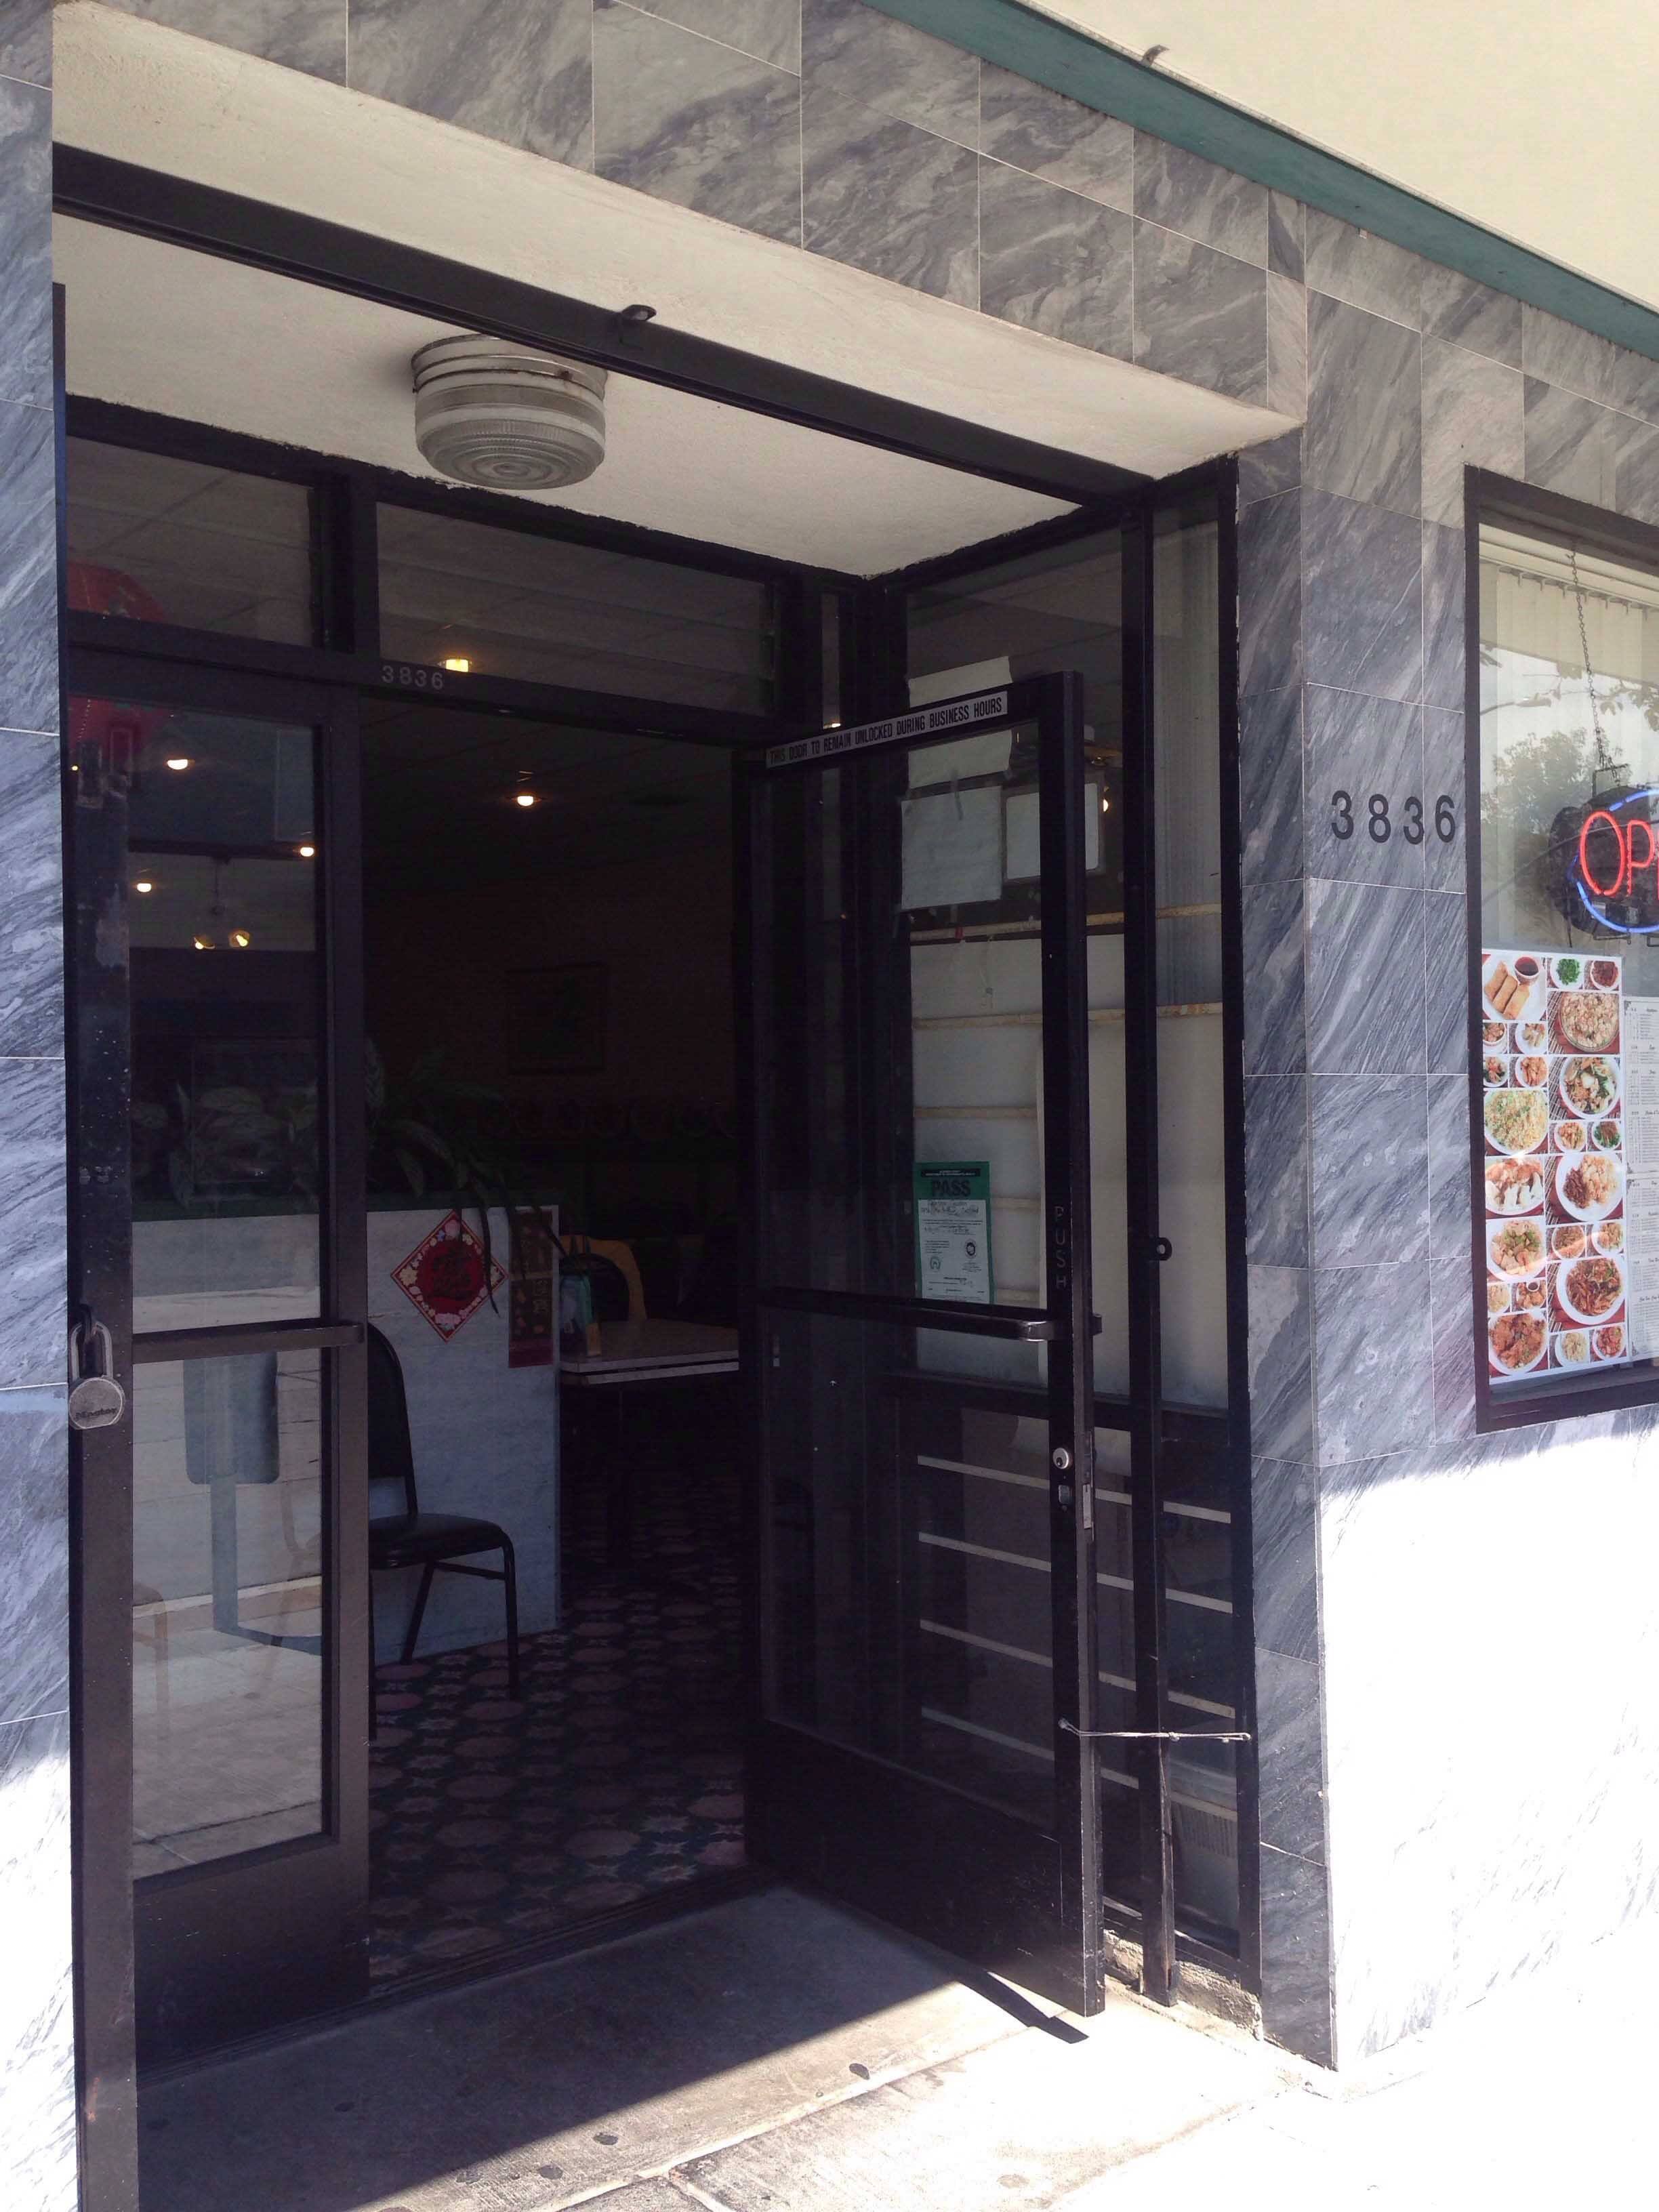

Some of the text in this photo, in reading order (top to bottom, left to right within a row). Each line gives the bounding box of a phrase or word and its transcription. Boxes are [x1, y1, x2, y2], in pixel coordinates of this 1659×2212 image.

[381, 665, 444, 691] 3836
[788, 743, 808, 760] DOOR
[811, 739, 821, 754] TO
[823, 732, 852, 753] REMAIN
[855, 723, 893, 745] UNLOCKED
[896, 715, 926, 736] DURING
[929, 704, 970, 729] BUSINESS
[972, 697, 1002, 718] HOURS
[1331, 790, 1456, 845] 3836
[1579, 811, 1659, 900] OP
[931, 1179, 971, 1197] PASS
[1054, 1205, 1067, 1290] PUSH
